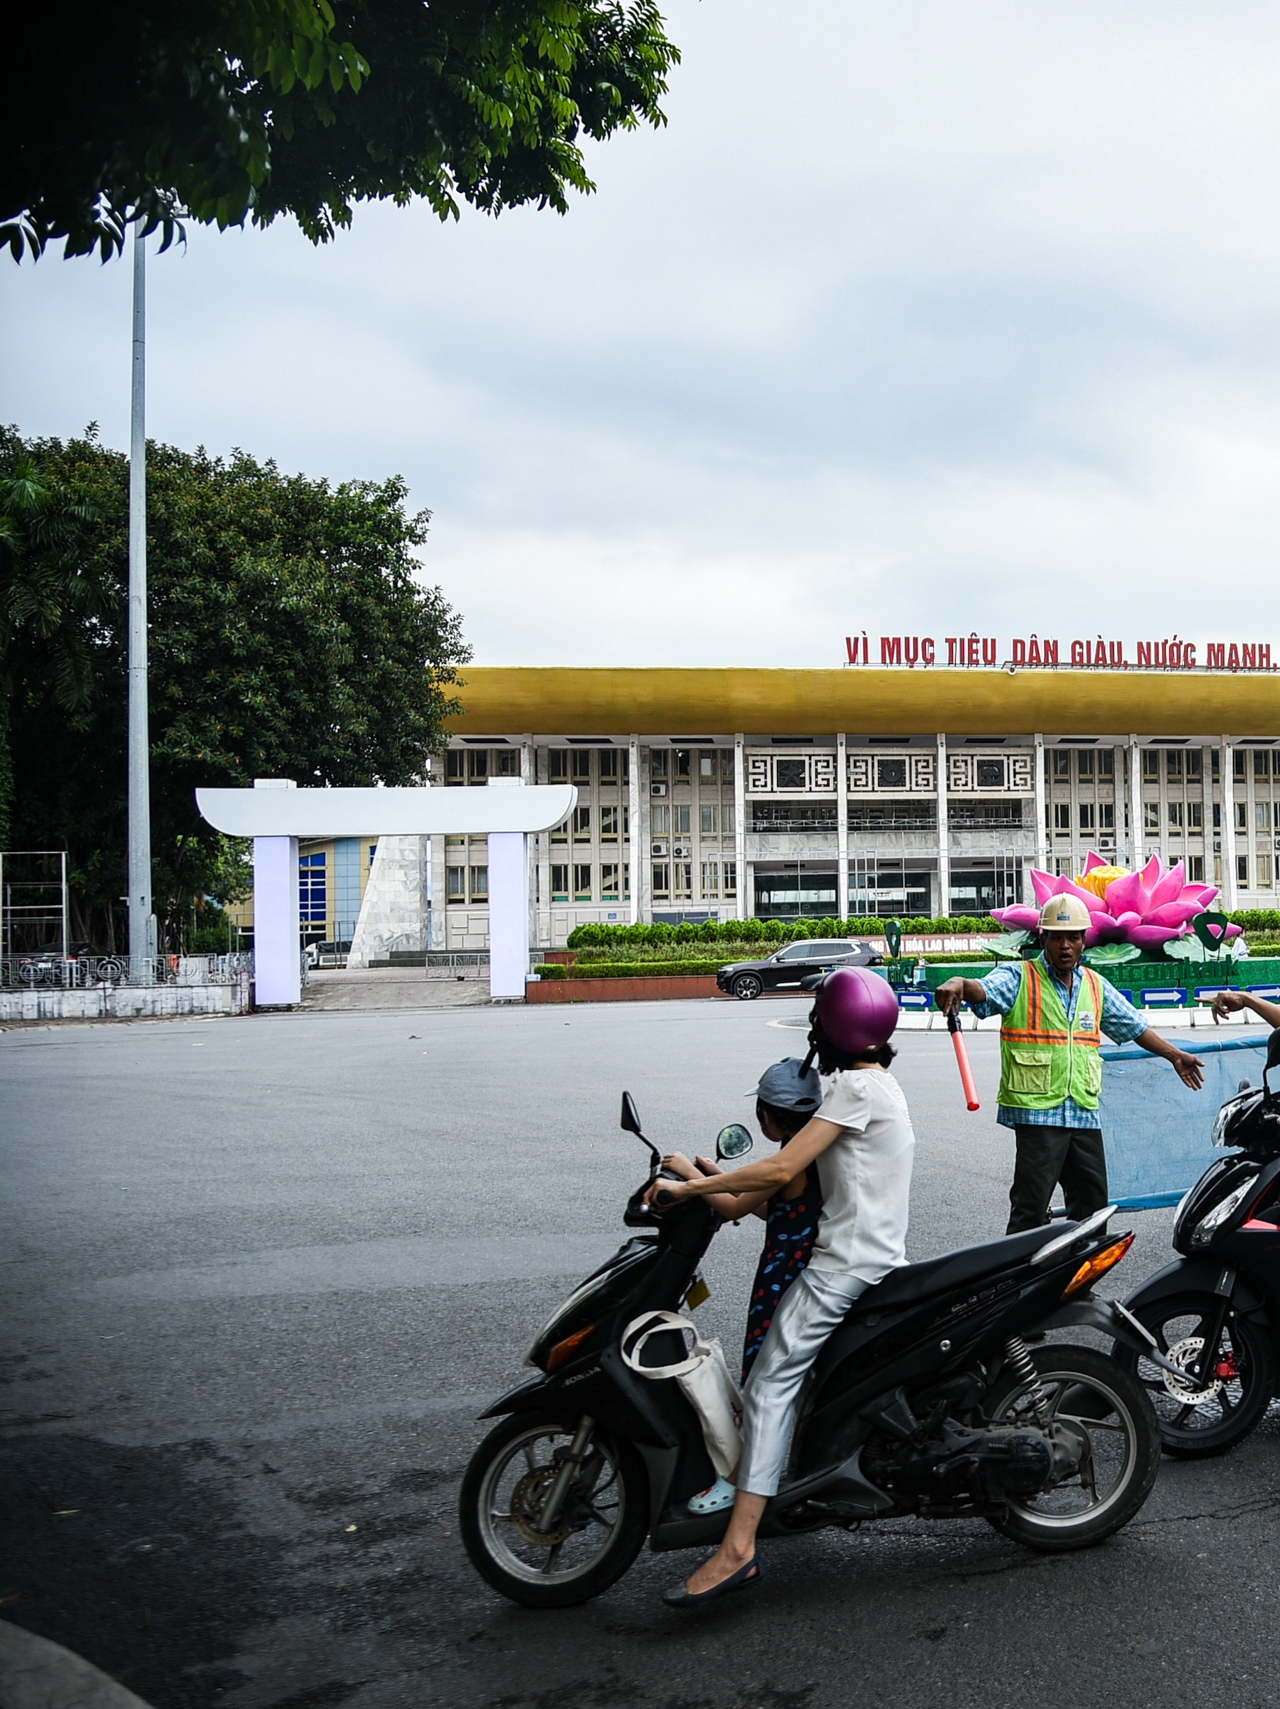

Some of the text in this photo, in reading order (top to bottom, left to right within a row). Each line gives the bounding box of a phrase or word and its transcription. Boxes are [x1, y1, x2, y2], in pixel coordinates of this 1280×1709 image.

[845, 631, 869, 665] VÌ
[880, 637, 935, 669] MỤC
[1012, 633, 1060, 667] DÂN
[1137, 635, 1197, 668] NƯỚC
[1207, 642, 1278, 674] MẠNH,
[905, 937, 924, 952] HÓA
[924, 939, 943, 952] LAO
[943, 935, 968, 954] ĐỘNG
